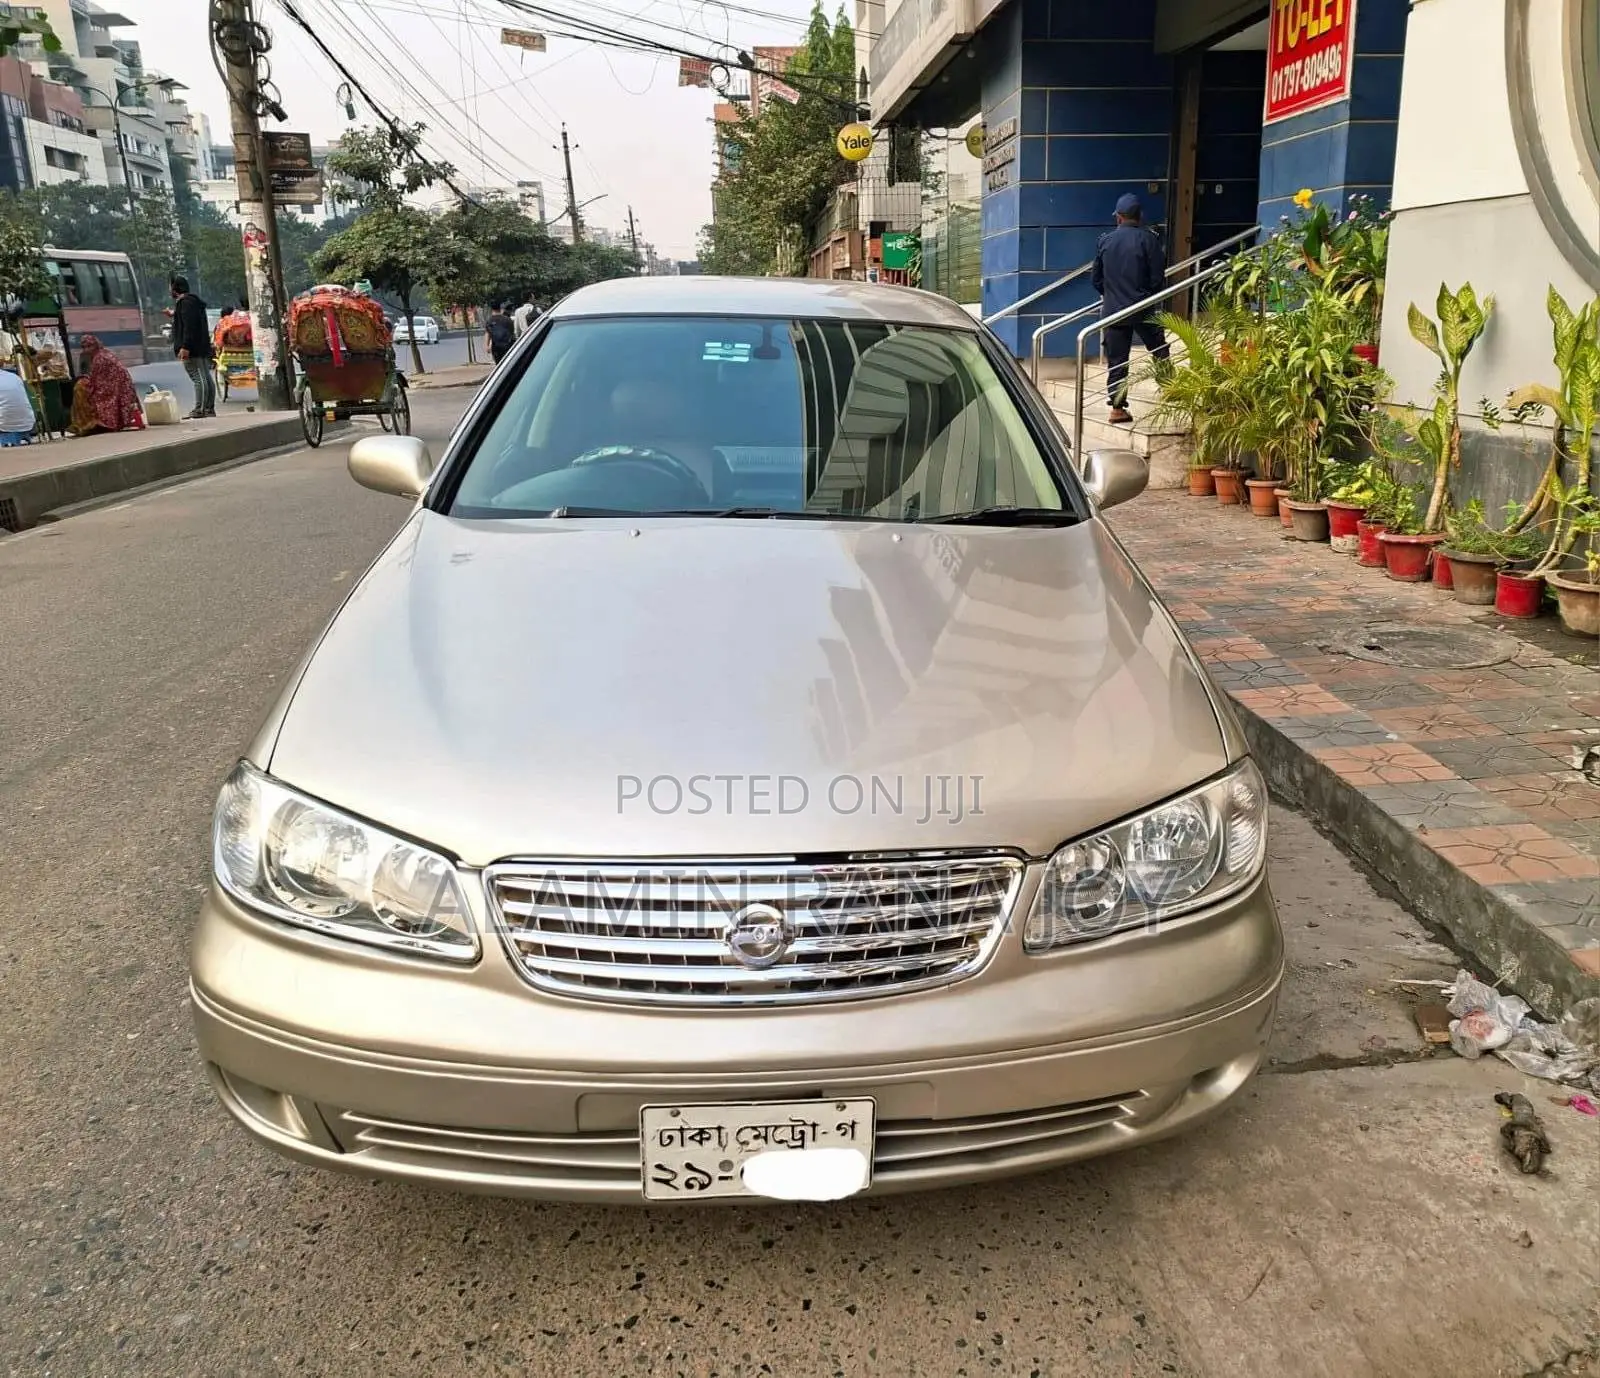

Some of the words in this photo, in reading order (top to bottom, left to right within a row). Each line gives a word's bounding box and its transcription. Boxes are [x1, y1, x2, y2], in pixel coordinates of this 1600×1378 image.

[1271, 43, 1343, 104] 01797-809496
[841, 134, 870, 150] Yale
[659, 1125, 725, 1149] ঢাকা
[652, 1161, 746, 1191] ২৯-
